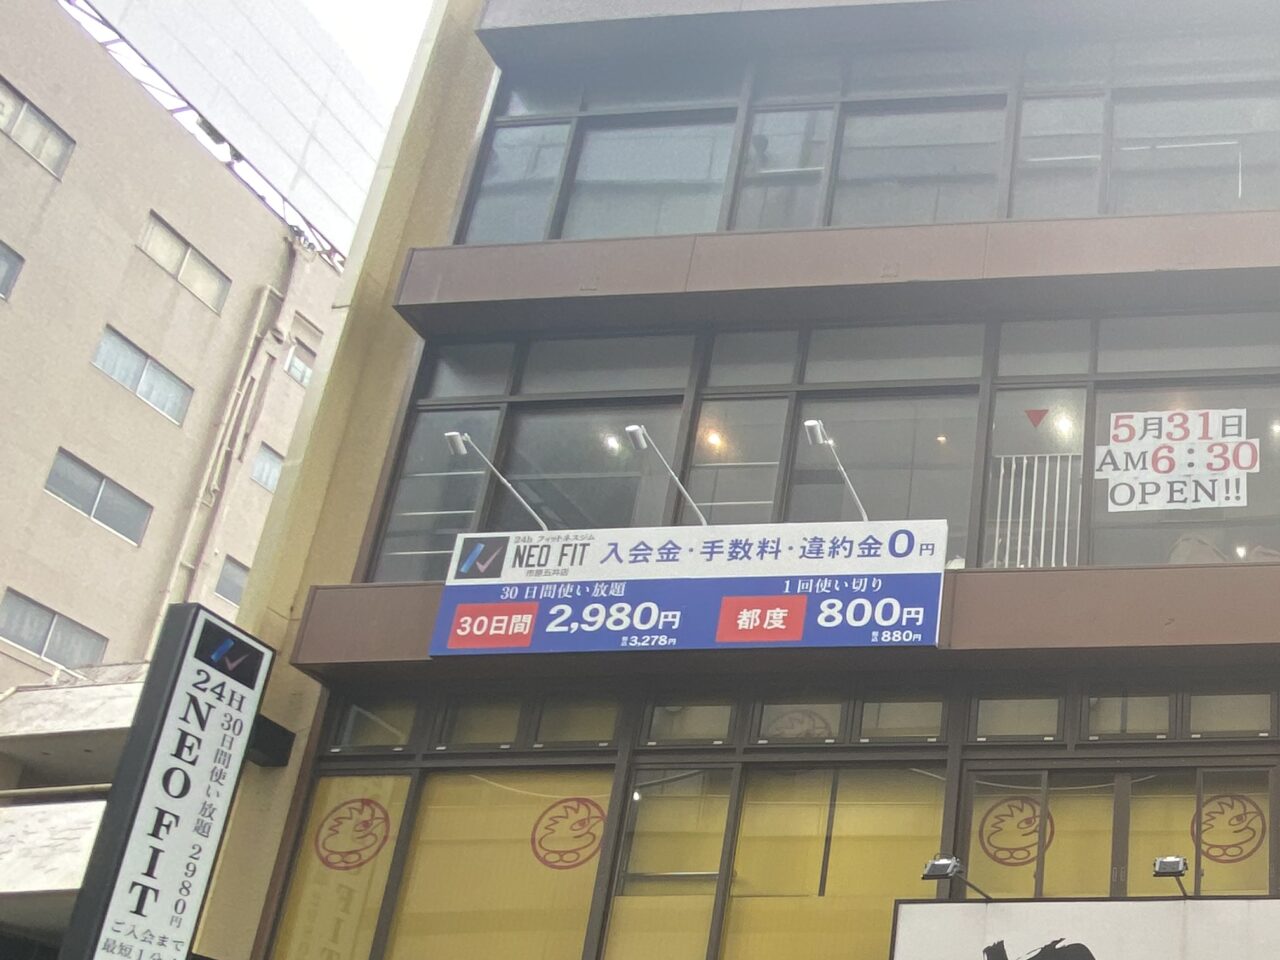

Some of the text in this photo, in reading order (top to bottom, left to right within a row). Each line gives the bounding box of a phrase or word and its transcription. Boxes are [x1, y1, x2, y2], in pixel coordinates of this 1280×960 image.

[1111, 411, 1243, 443] 5月31日
[1109, 477, 1242, 506] OPEN!!
[511, 543, 591, 568] NEO FIT
[456, 613, 532, 636] 30日間
[545, 600, 682, 634] 2,980円
[736, 607, 789, 630] 都度
[816, 598, 924, 627] 800円
[192, 668, 247, 713] 24H
[110, 919, 186, 953] ご入会まで
